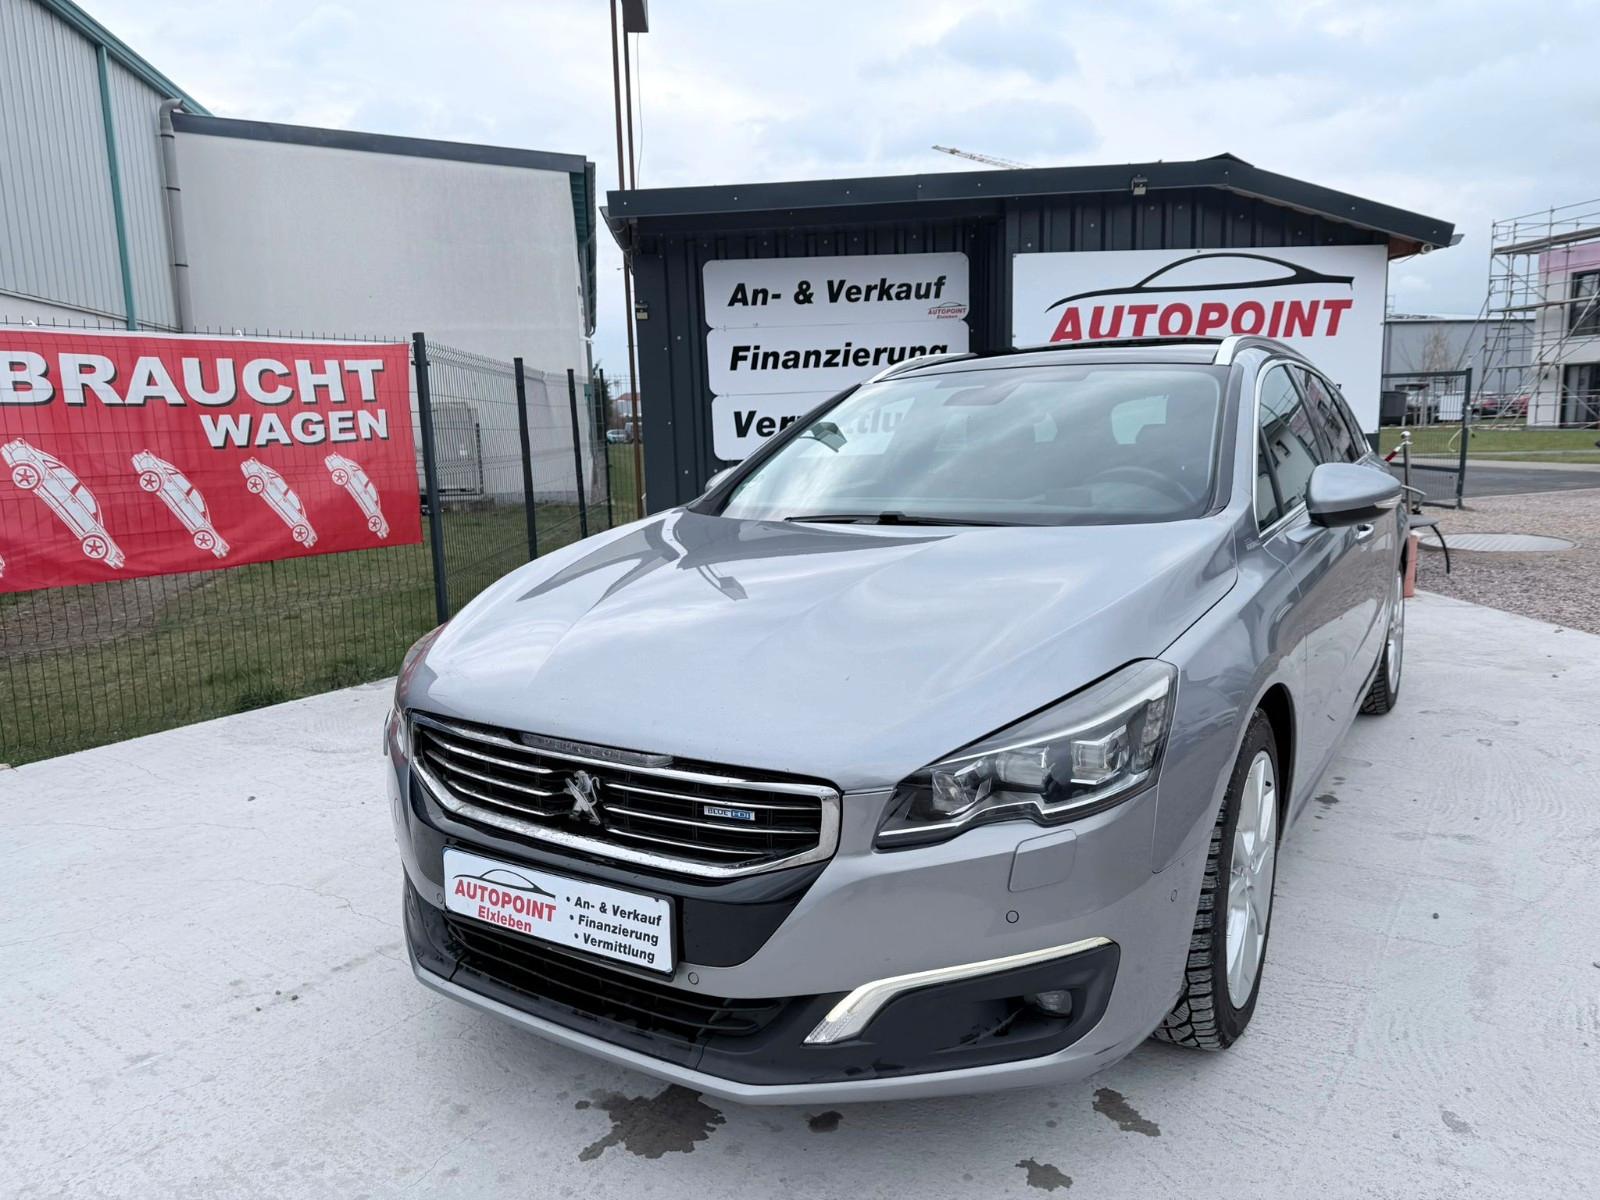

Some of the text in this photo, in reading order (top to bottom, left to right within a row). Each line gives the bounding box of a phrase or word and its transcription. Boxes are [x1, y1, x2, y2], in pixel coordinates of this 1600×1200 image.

[728, 275, 947, 307] An- & Verkauf
[928, 307, 967, 315] AUTOPOINT
[1050, 299, 1353, 342] AUTOPOINT
[200, 409, 389, 449] WAGEN
[455, 879, 557, 922] AUTOPOINT
[574, 897, 662, 926] An- & Verkauf
[478, 905, 532, 933] Elxleben
[578, 915, 659, 946] Finanzierung
[583, 933, 655, 963] Vermittlung
